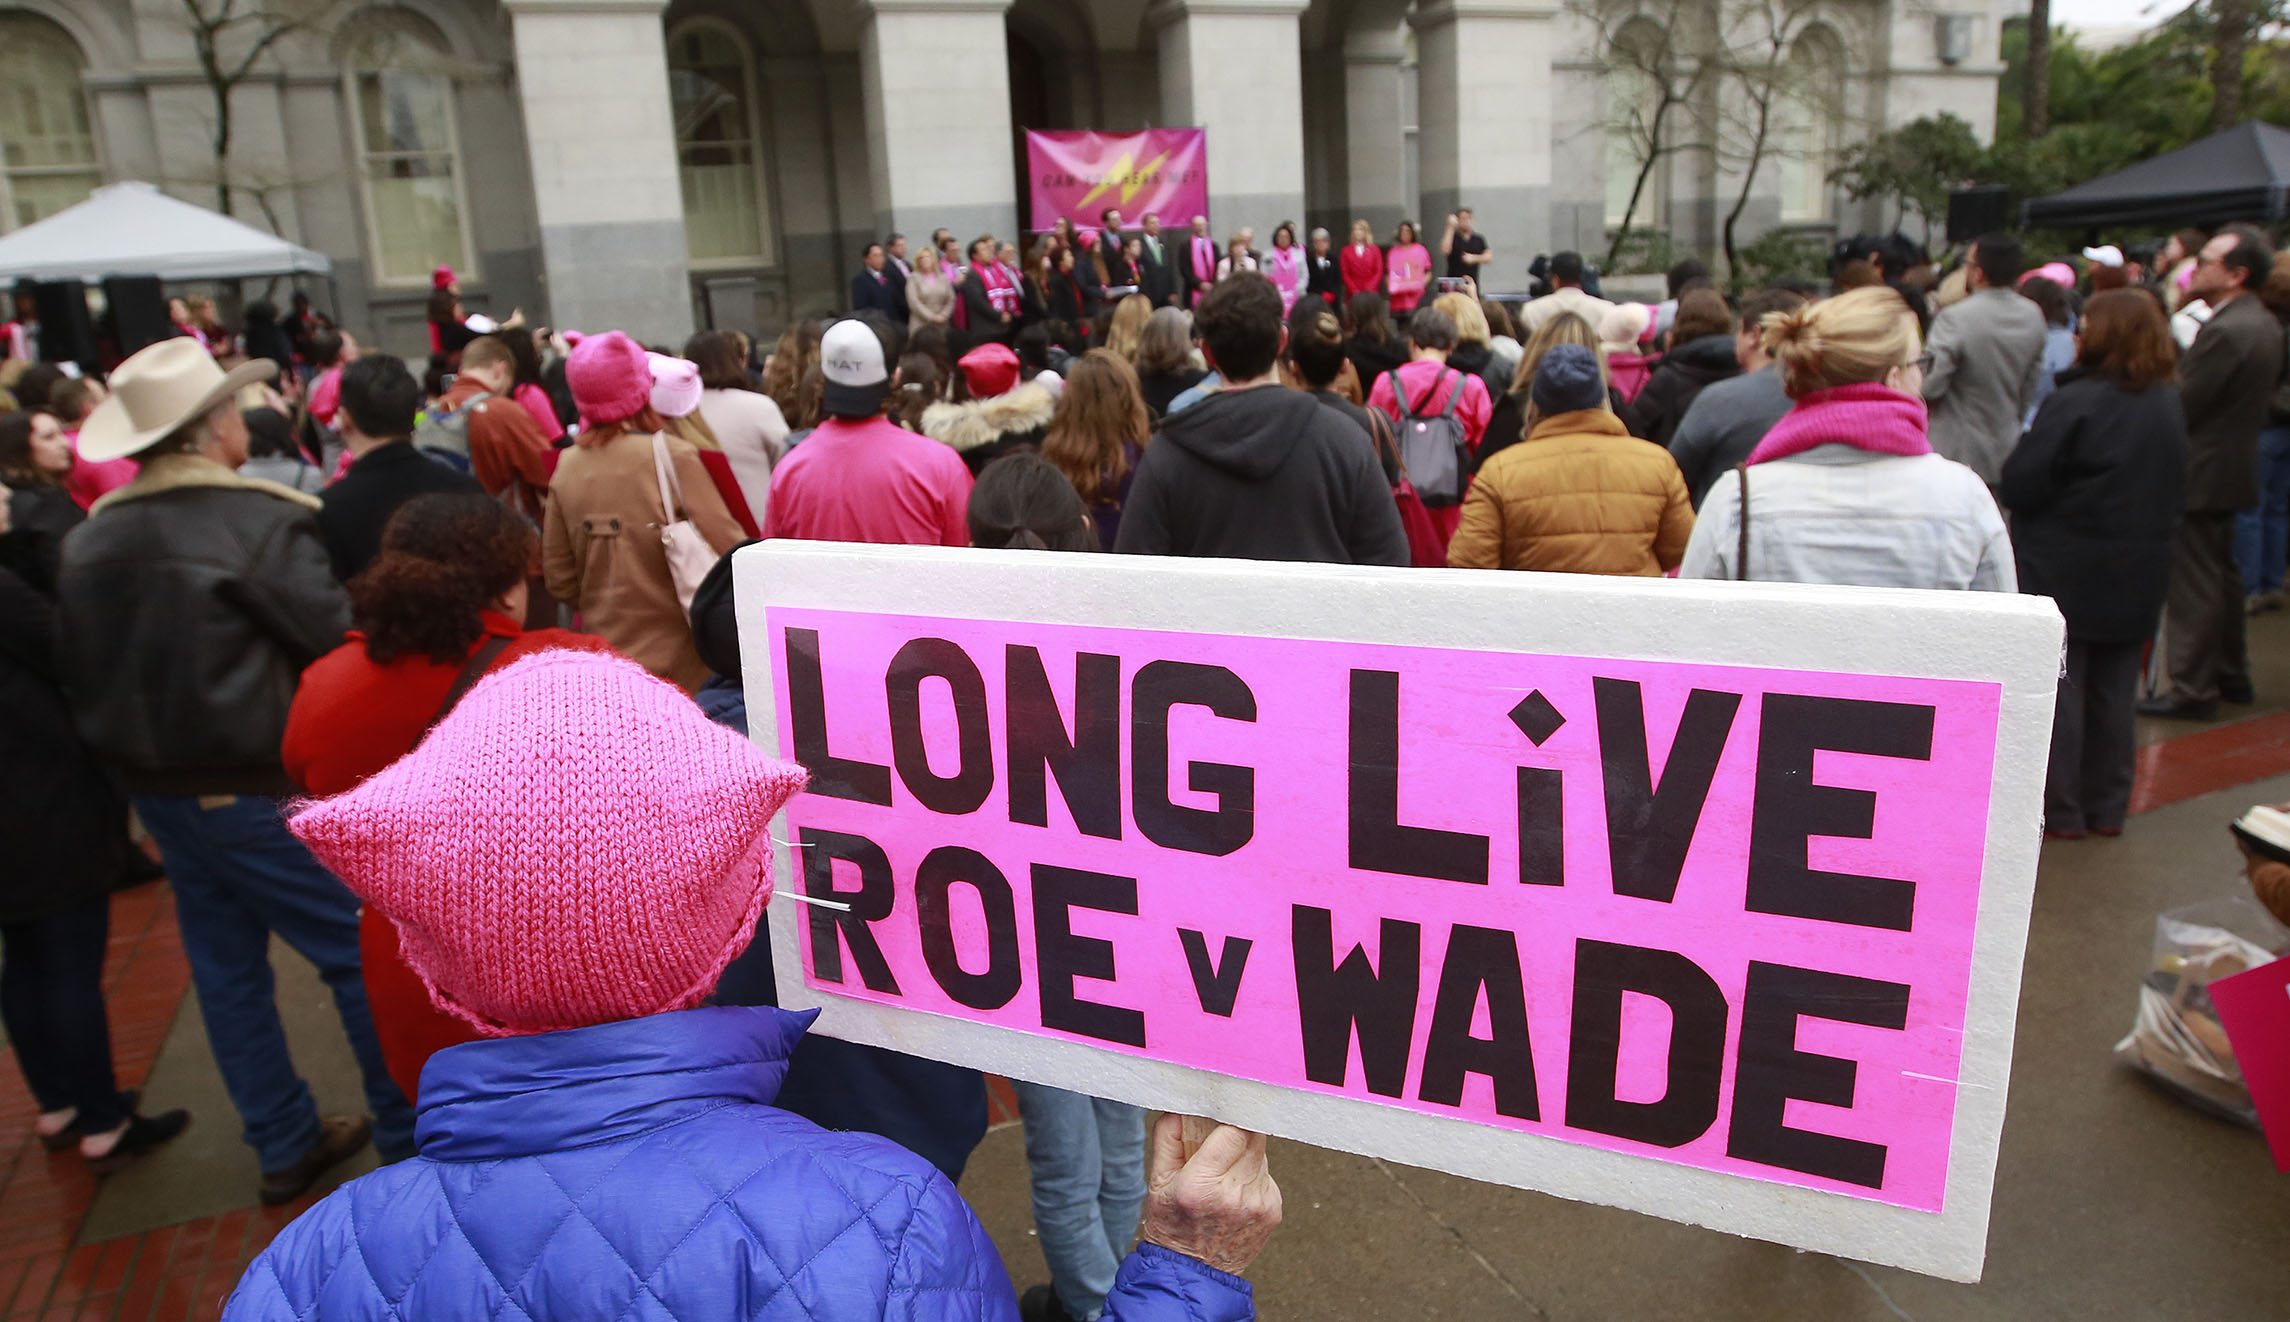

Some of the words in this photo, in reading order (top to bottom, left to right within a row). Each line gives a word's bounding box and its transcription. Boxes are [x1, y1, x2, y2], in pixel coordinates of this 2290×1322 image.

[785, 626, 1257, 857] LONG
[799, 827, 1146, 1048] ROE
[1291, 904, 1911, 1190] WADE
